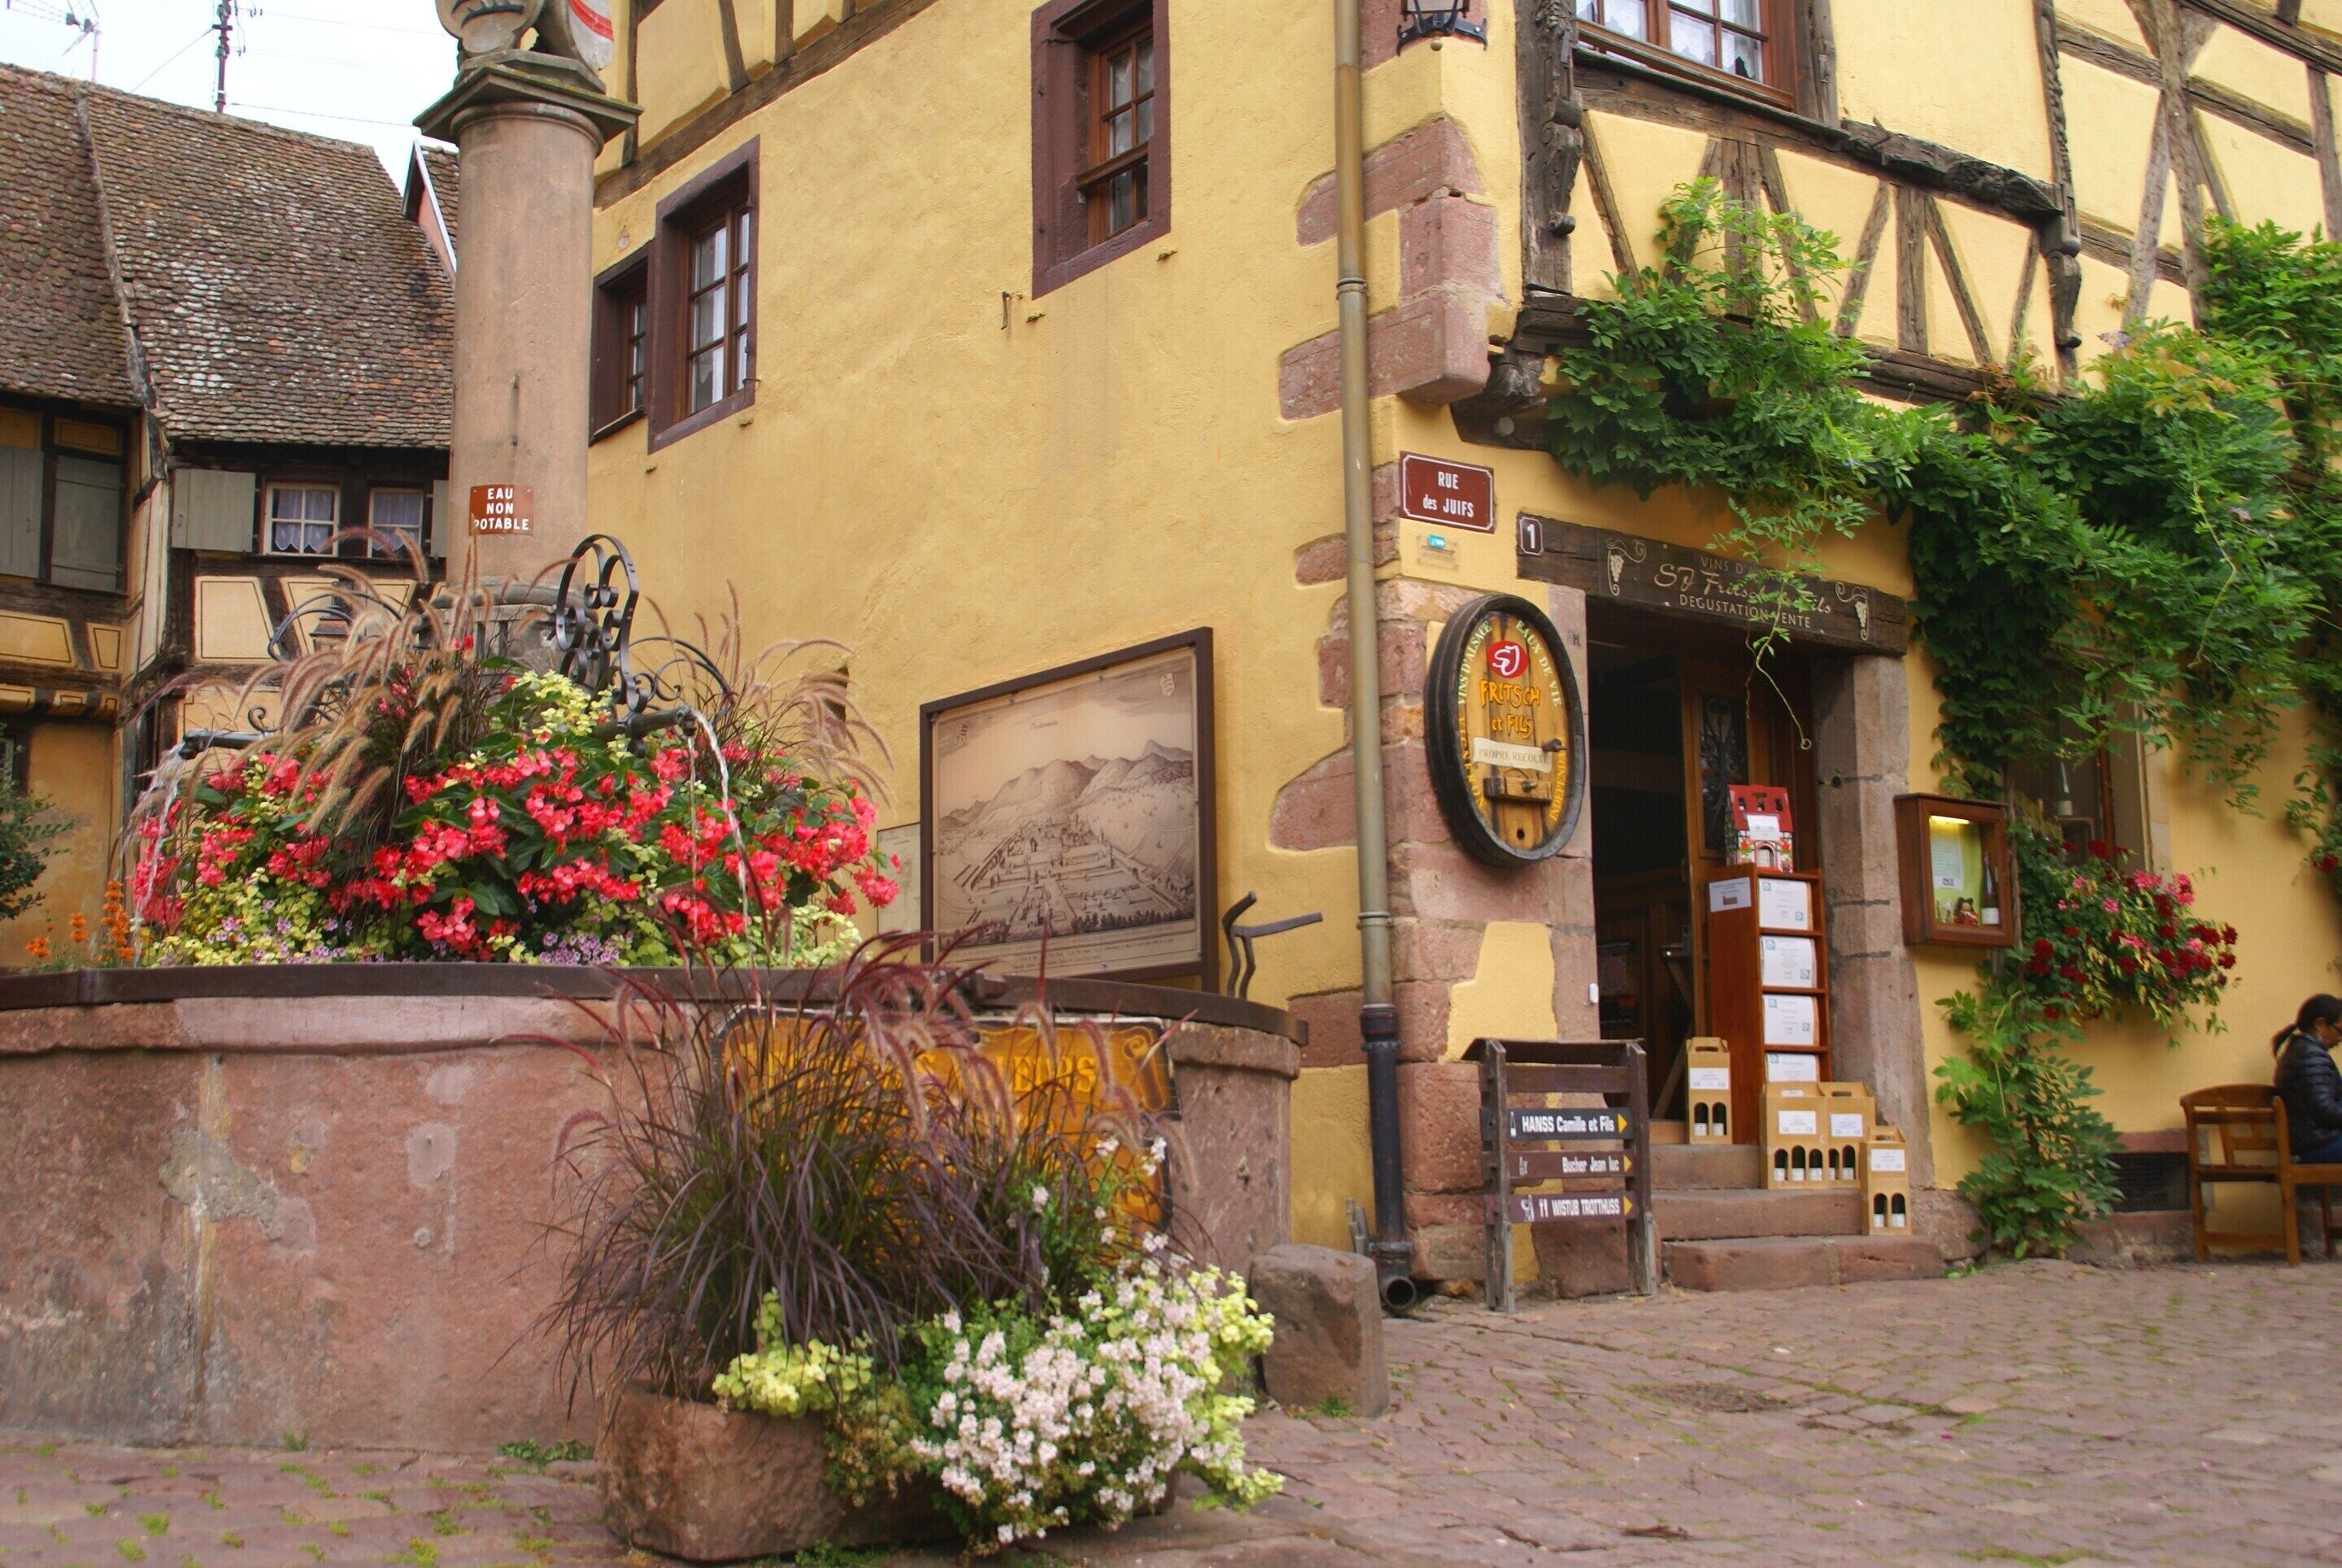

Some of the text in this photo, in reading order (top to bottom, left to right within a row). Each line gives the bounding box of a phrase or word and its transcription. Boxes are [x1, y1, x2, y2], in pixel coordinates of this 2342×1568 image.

[1438, 471, 1459, 490] RUE
[487, 487, 513, 500] EAU
[486, 502, 514, 515] NON
[1423, 494, 1474, 518] des JUIFS
[1526, 523, 1536, 549] 1
[1700, 555, 1729, 572] VINS
[1771, 612, 1811, 629] ENTE
[1515, 619, 1563, 707] EAUX DE VIE
[1457, 674, 1469, 705] VINS
[1478, 679, 1542, 708] FRITSCH
[1491, 713, 1533, 739] et FILS
[1478, 747, 1509, 760] PROPRE
[1521, 1115, 1615, 1133] HANSS Camille et Fils
[1561, 1156, 1587, 1174] Bucher
[1590, 1155, 1607, 1173] Jean
[1552, 1199, 1580, 1217] WISTUB
